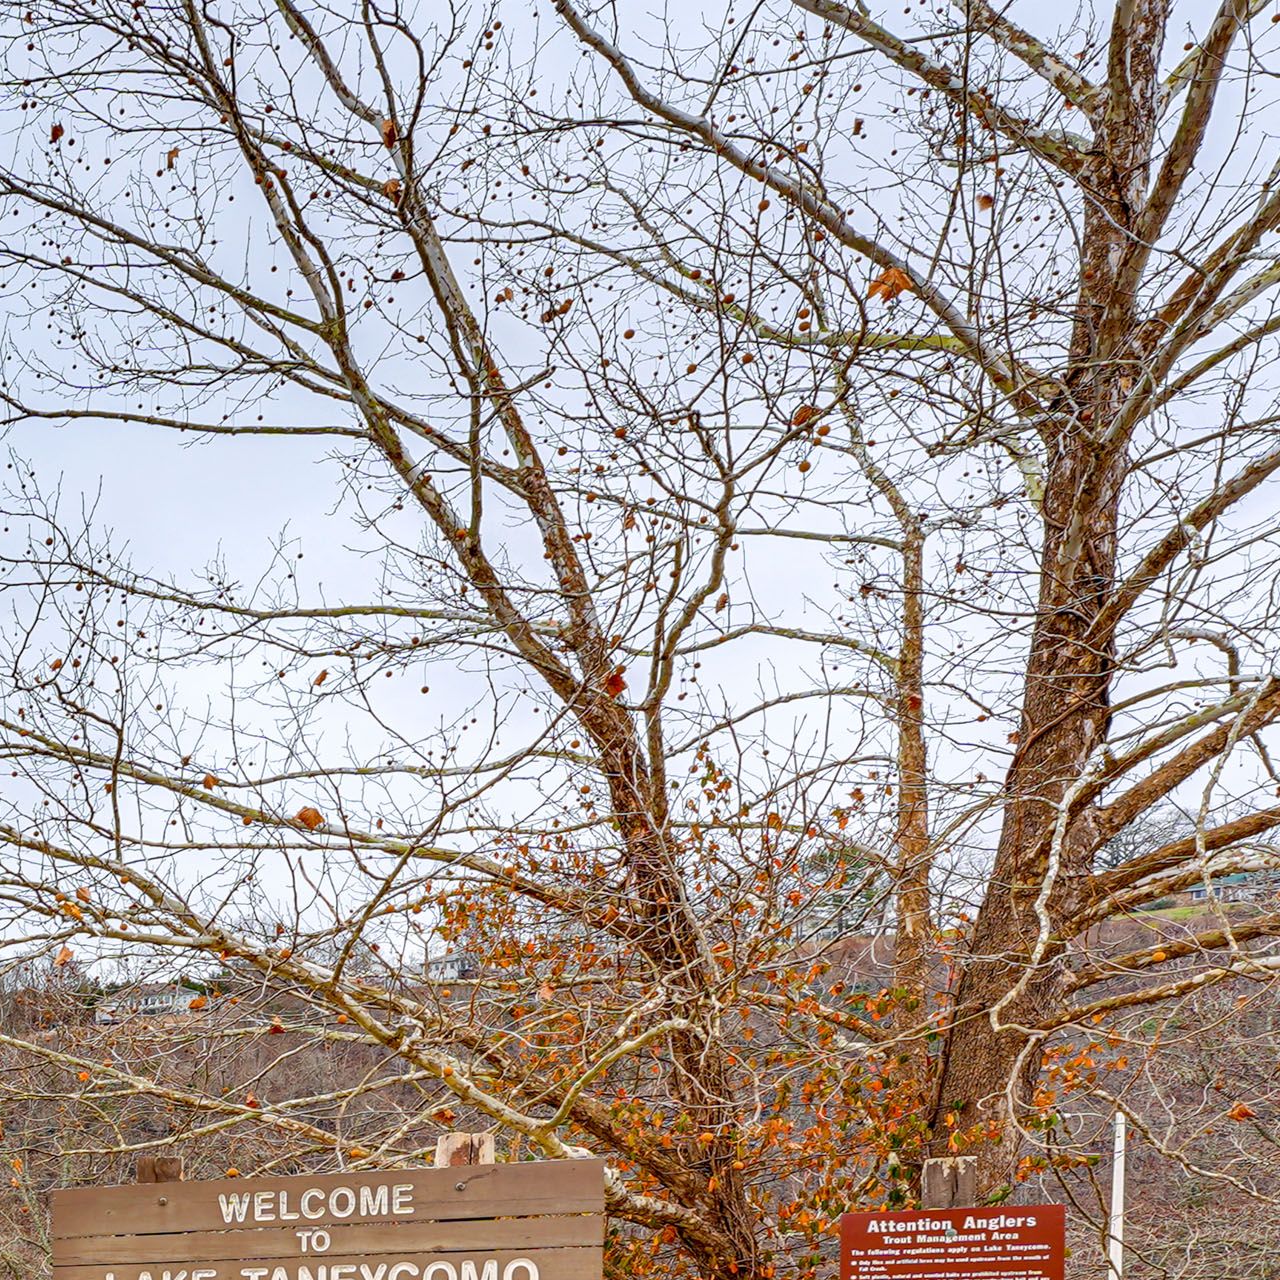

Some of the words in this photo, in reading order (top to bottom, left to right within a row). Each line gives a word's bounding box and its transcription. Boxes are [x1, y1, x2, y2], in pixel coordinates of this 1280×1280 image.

[218, 1184, 415, 1223] WELCOME
[867, 1218, 952, 1233] Attention
[963, 1215, 1037, 1230] Anglers
[295, 1230, 331, 1253] TO
[882, 1235, 912, 1245] Trout
[916, 1232, 986, 1244] Management
[992, 1232, 1019, 1241] Area
